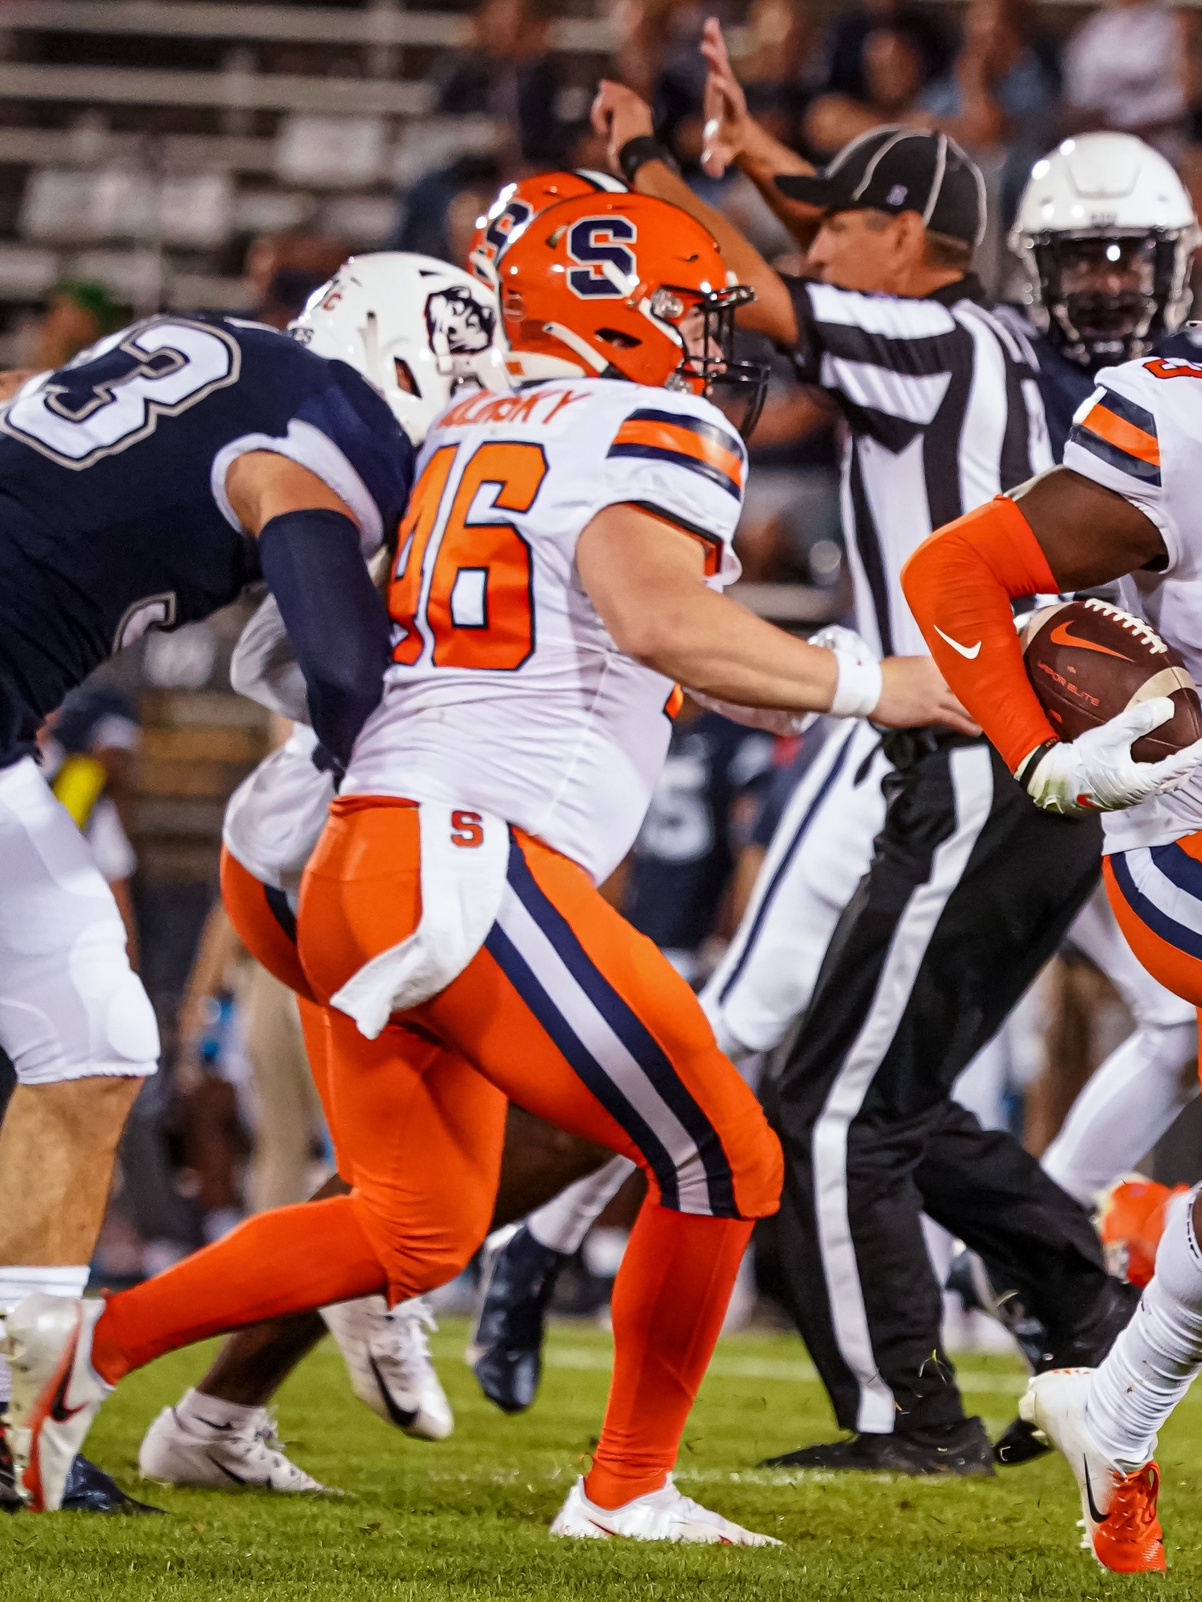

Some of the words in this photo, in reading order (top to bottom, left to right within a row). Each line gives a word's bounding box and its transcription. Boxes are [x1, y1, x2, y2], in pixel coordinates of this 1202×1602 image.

[567, 214, 638, 299] S
[2, 315, 241, 470] 3
[1067, 683, 1100, 707] ELITE
[450, 809, 484, 848] S
